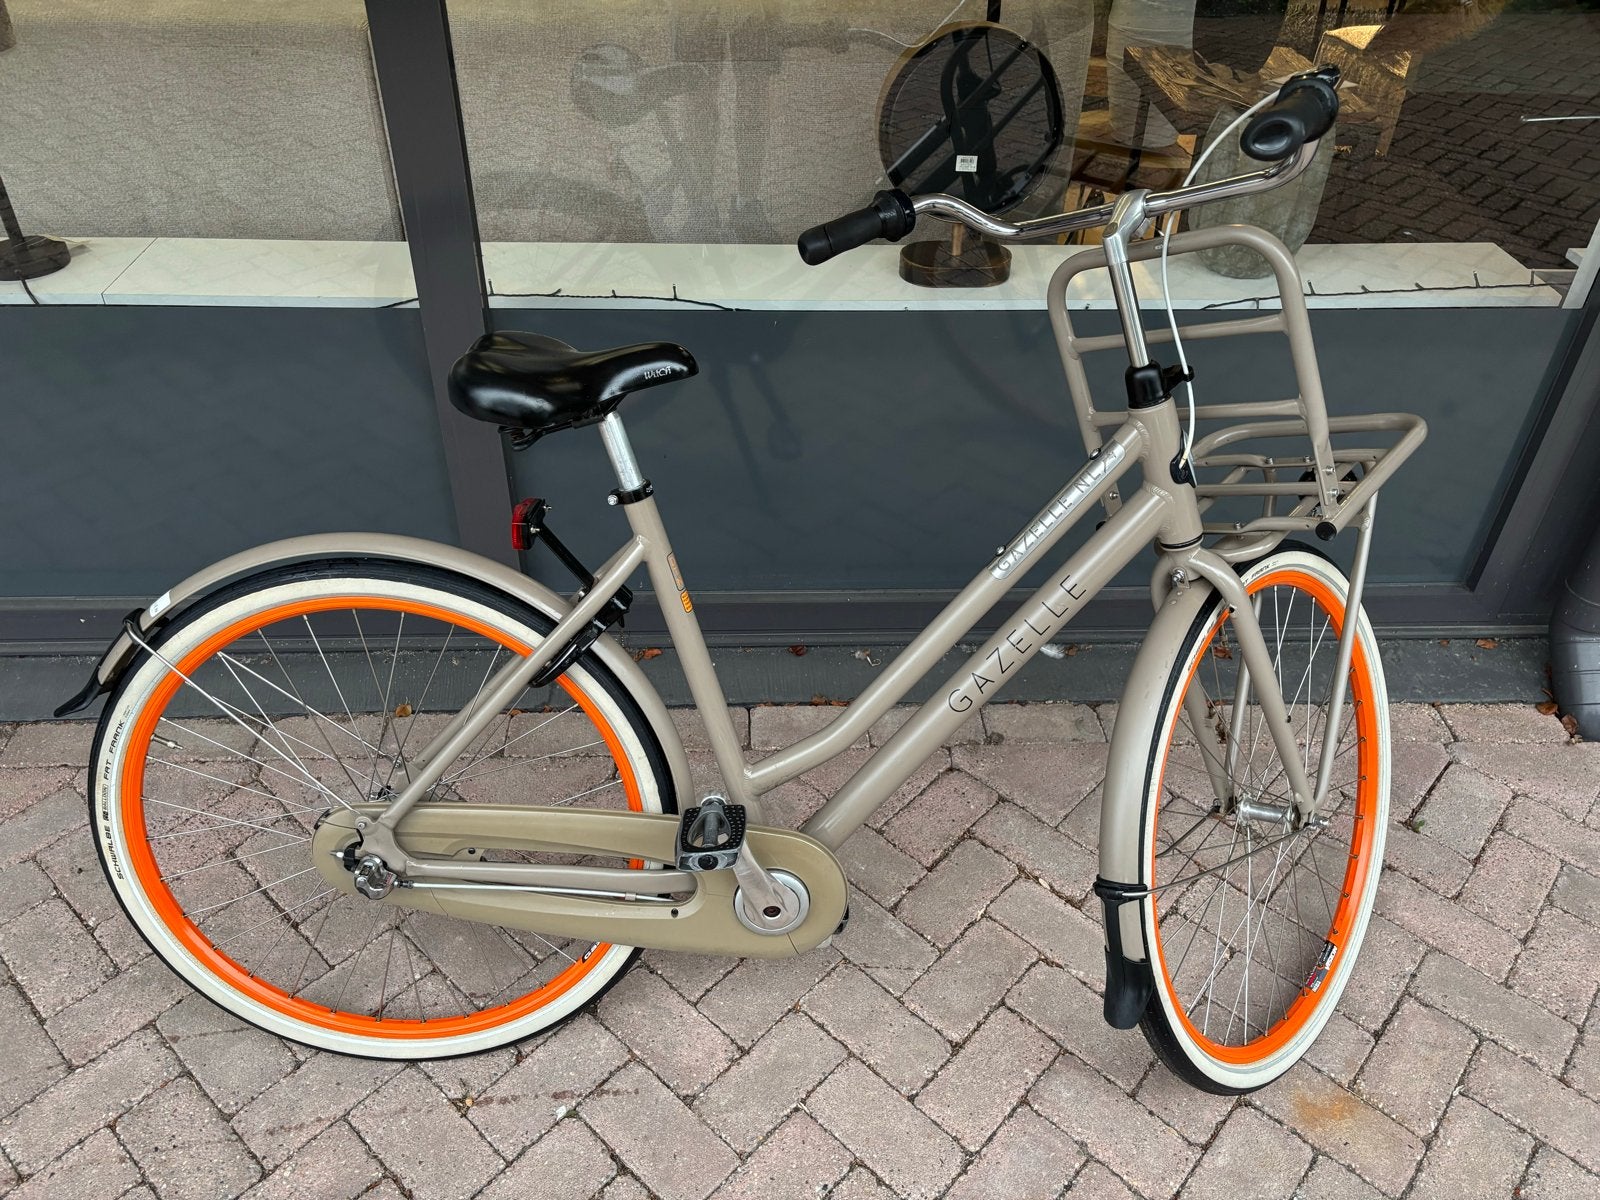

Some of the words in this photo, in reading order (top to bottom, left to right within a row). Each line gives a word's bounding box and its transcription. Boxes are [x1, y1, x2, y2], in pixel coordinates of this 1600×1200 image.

[997, 496, 1073, 572] GAZELLE
[948, 574, 1087, 713] GAZELLE
[108, 719, 125, 754] FRANK
[103, 758, 112, 781] FAT
[104, 825, 125, 880] SCHWALBE
